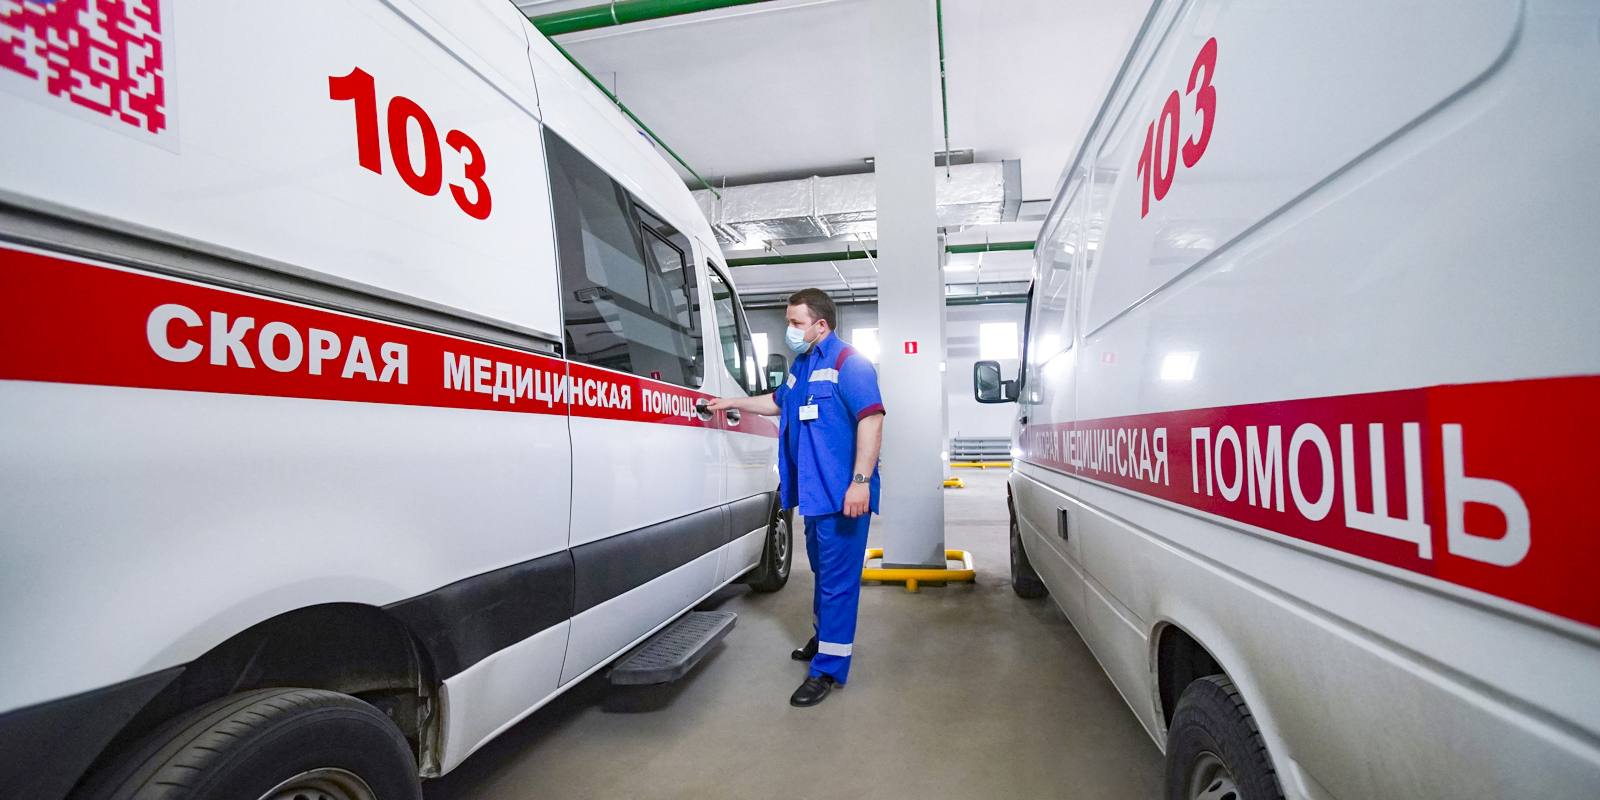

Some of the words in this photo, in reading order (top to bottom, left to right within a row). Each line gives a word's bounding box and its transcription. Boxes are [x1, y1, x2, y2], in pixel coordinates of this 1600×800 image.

[328, 66, 492, 220] 103
[1137, 37, 1218, 220] 103
[146, 303, 408, 384] СКОРАЯ
[443, 351, 631, 409] МЕДИЦИНСКАЯ
[642, 388, 697, 421] ПОМОЩЬ
[1063, 427, 1170, 486] МЕДИЦИНСКАЯ
[1191, 422, 1531, 567] ПОМОЩЬ
